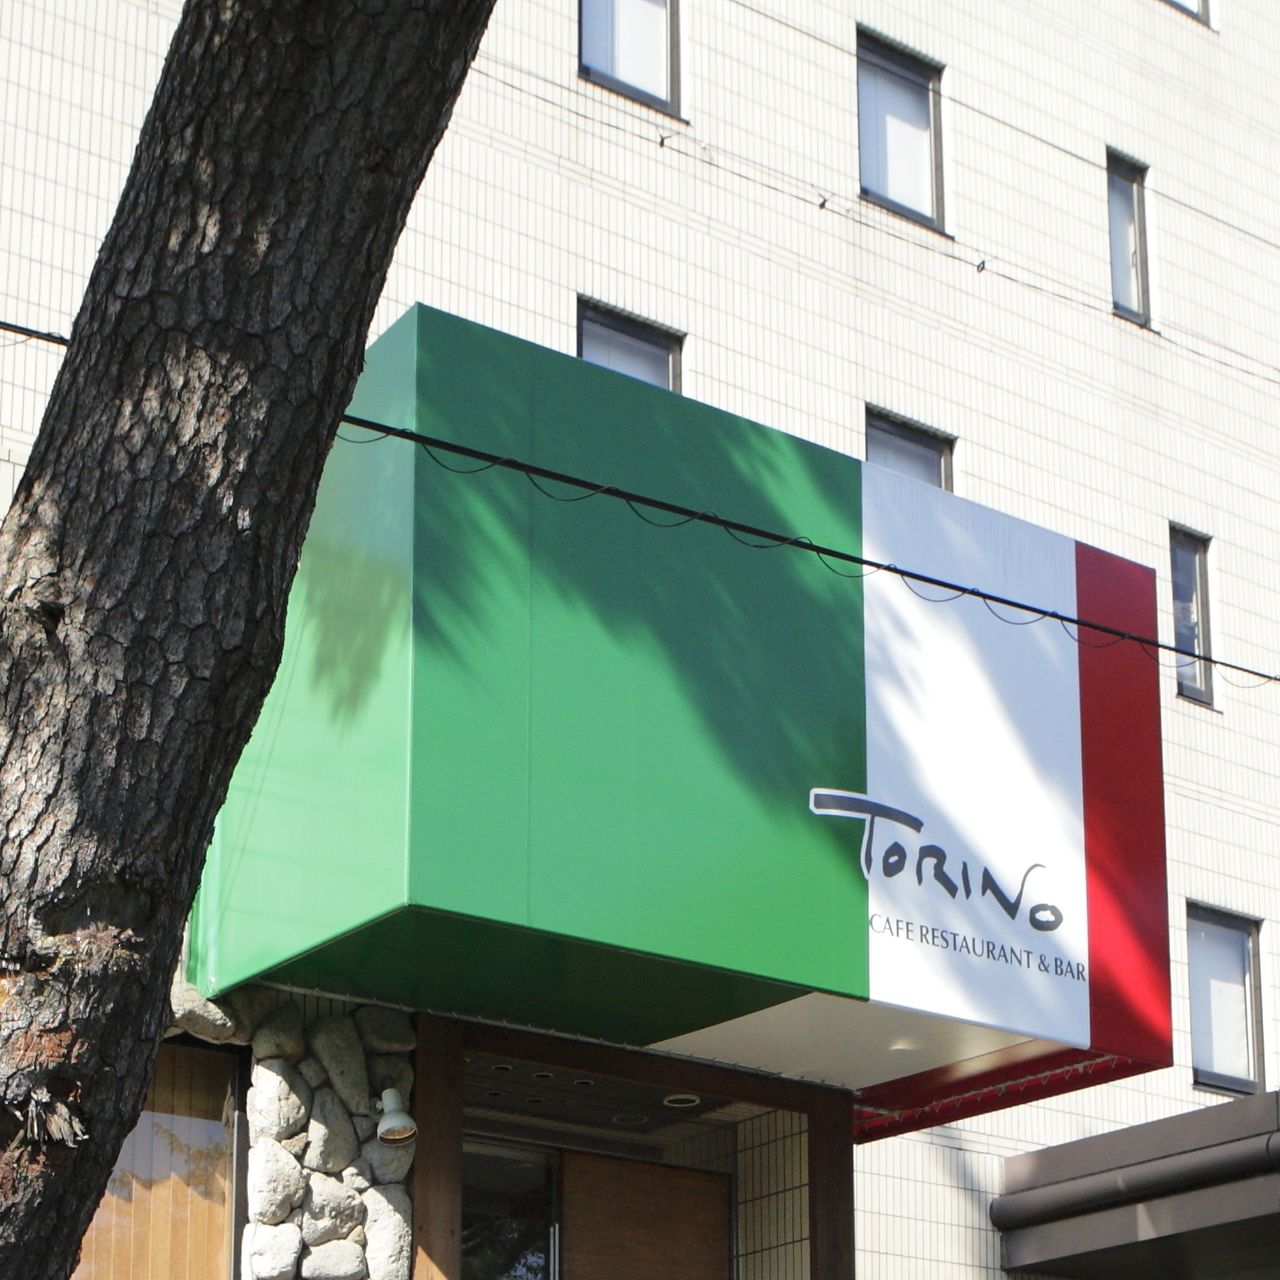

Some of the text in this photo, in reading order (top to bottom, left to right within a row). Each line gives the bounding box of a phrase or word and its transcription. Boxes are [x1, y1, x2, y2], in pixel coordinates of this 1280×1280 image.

[810, 790, 1063, 932] TORINO
[869, 913, 1087, 982] CAFE RESTAURANT & BAR
